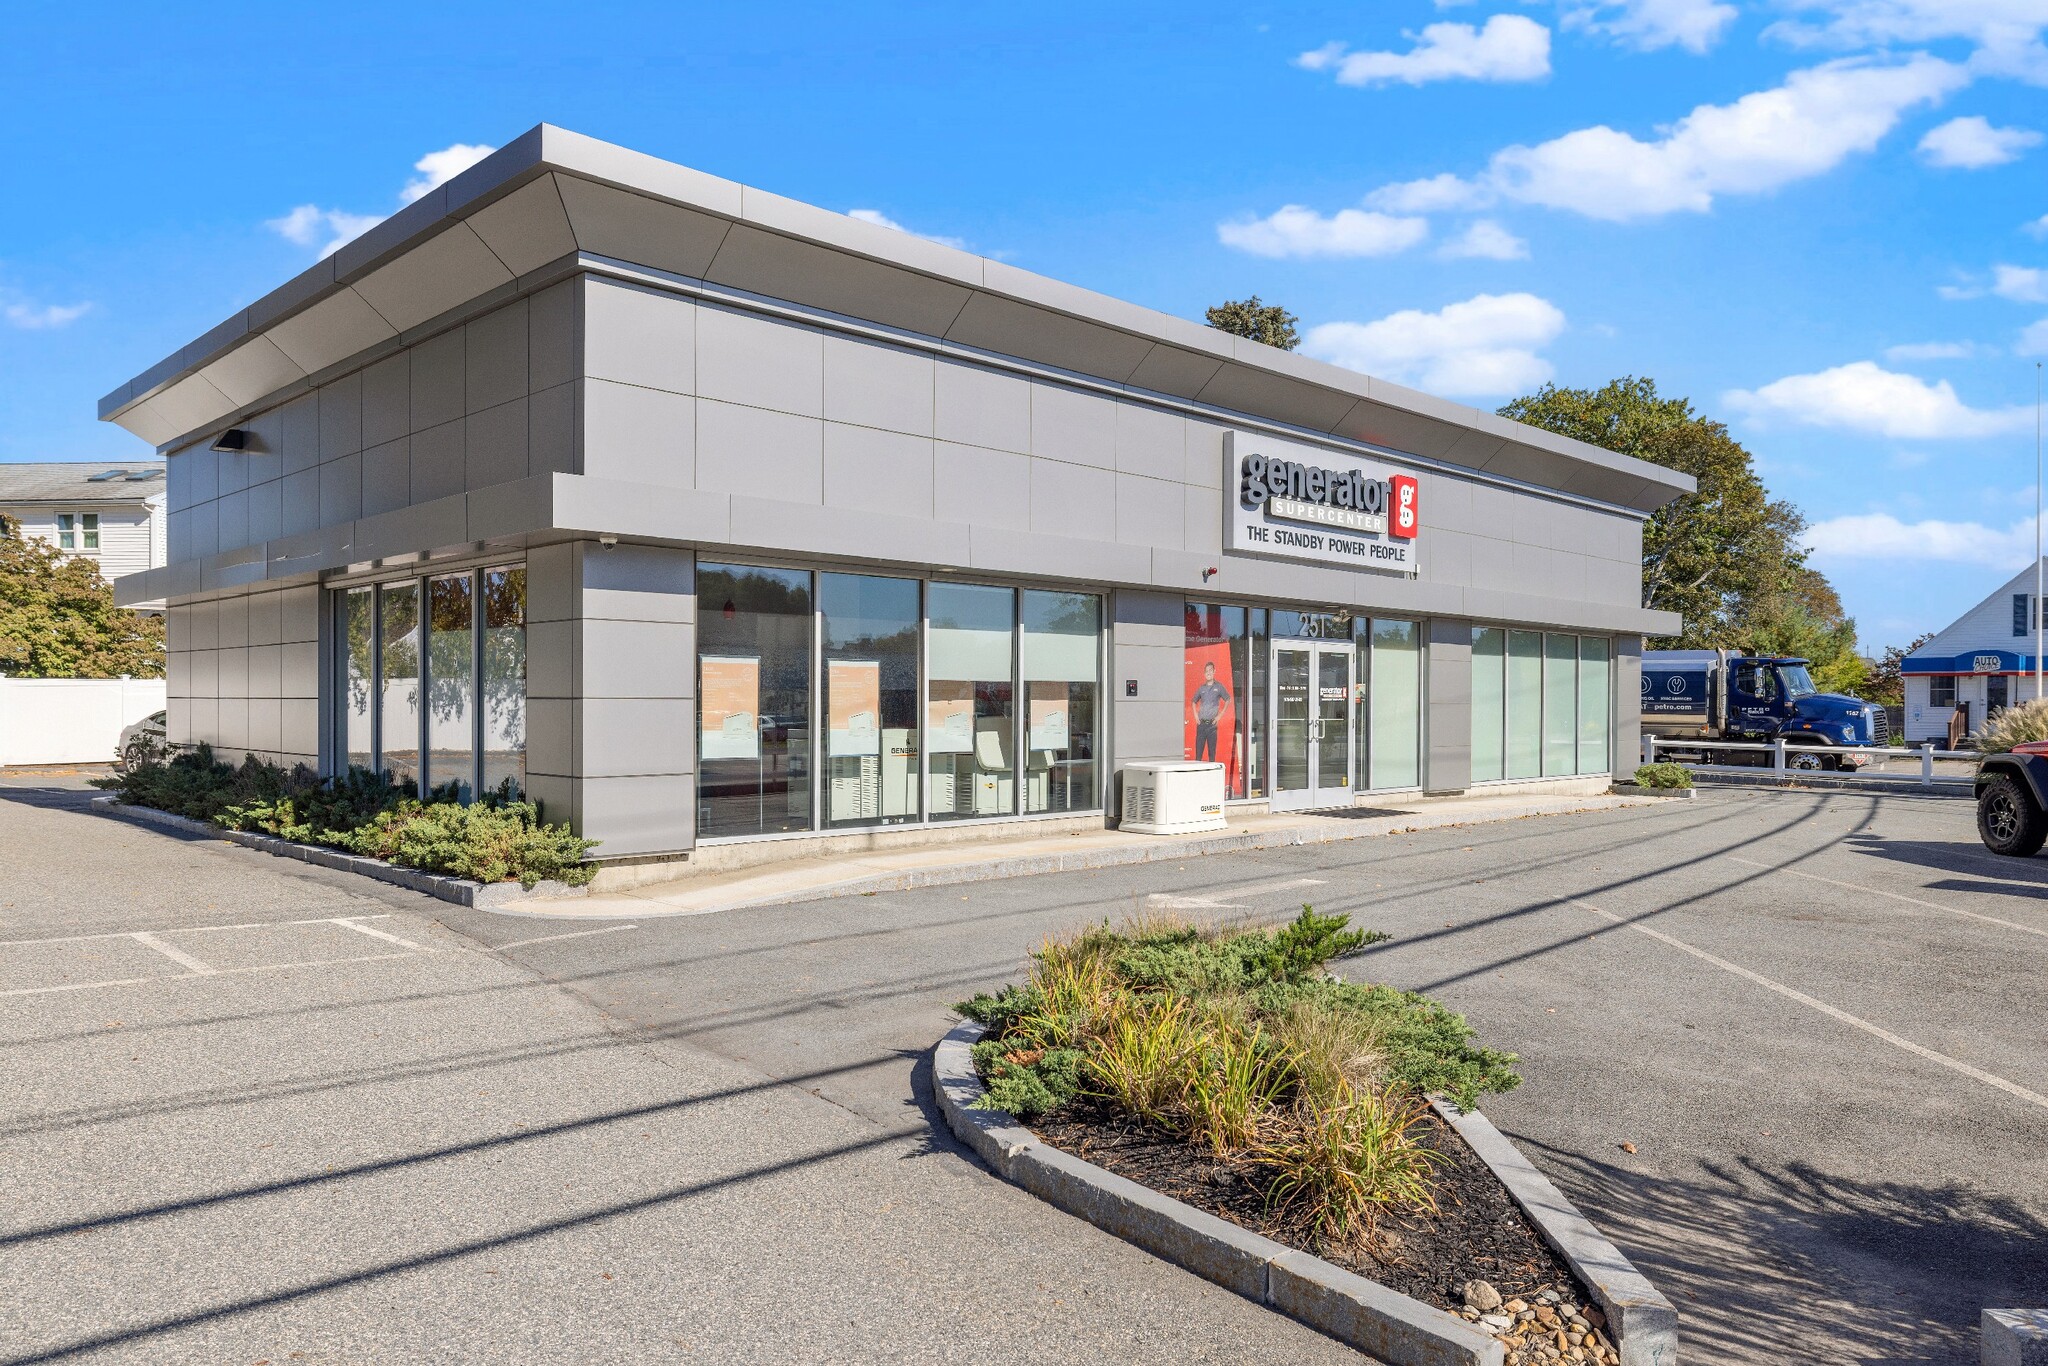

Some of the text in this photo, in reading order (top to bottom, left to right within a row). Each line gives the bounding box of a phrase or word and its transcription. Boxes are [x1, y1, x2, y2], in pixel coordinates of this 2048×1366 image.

[1243, 453, 1391, 514] generator
[1276, 501, 1381, 530] SUPERCENTER
[1247, 525, 1406, 561] THE STANDBY POWER PEOPLE
[1298, 613, 1325, 638] 251
[1975, 656, 1998, 666] AUTO
[1654, 703, 1692, 711] petro.com
